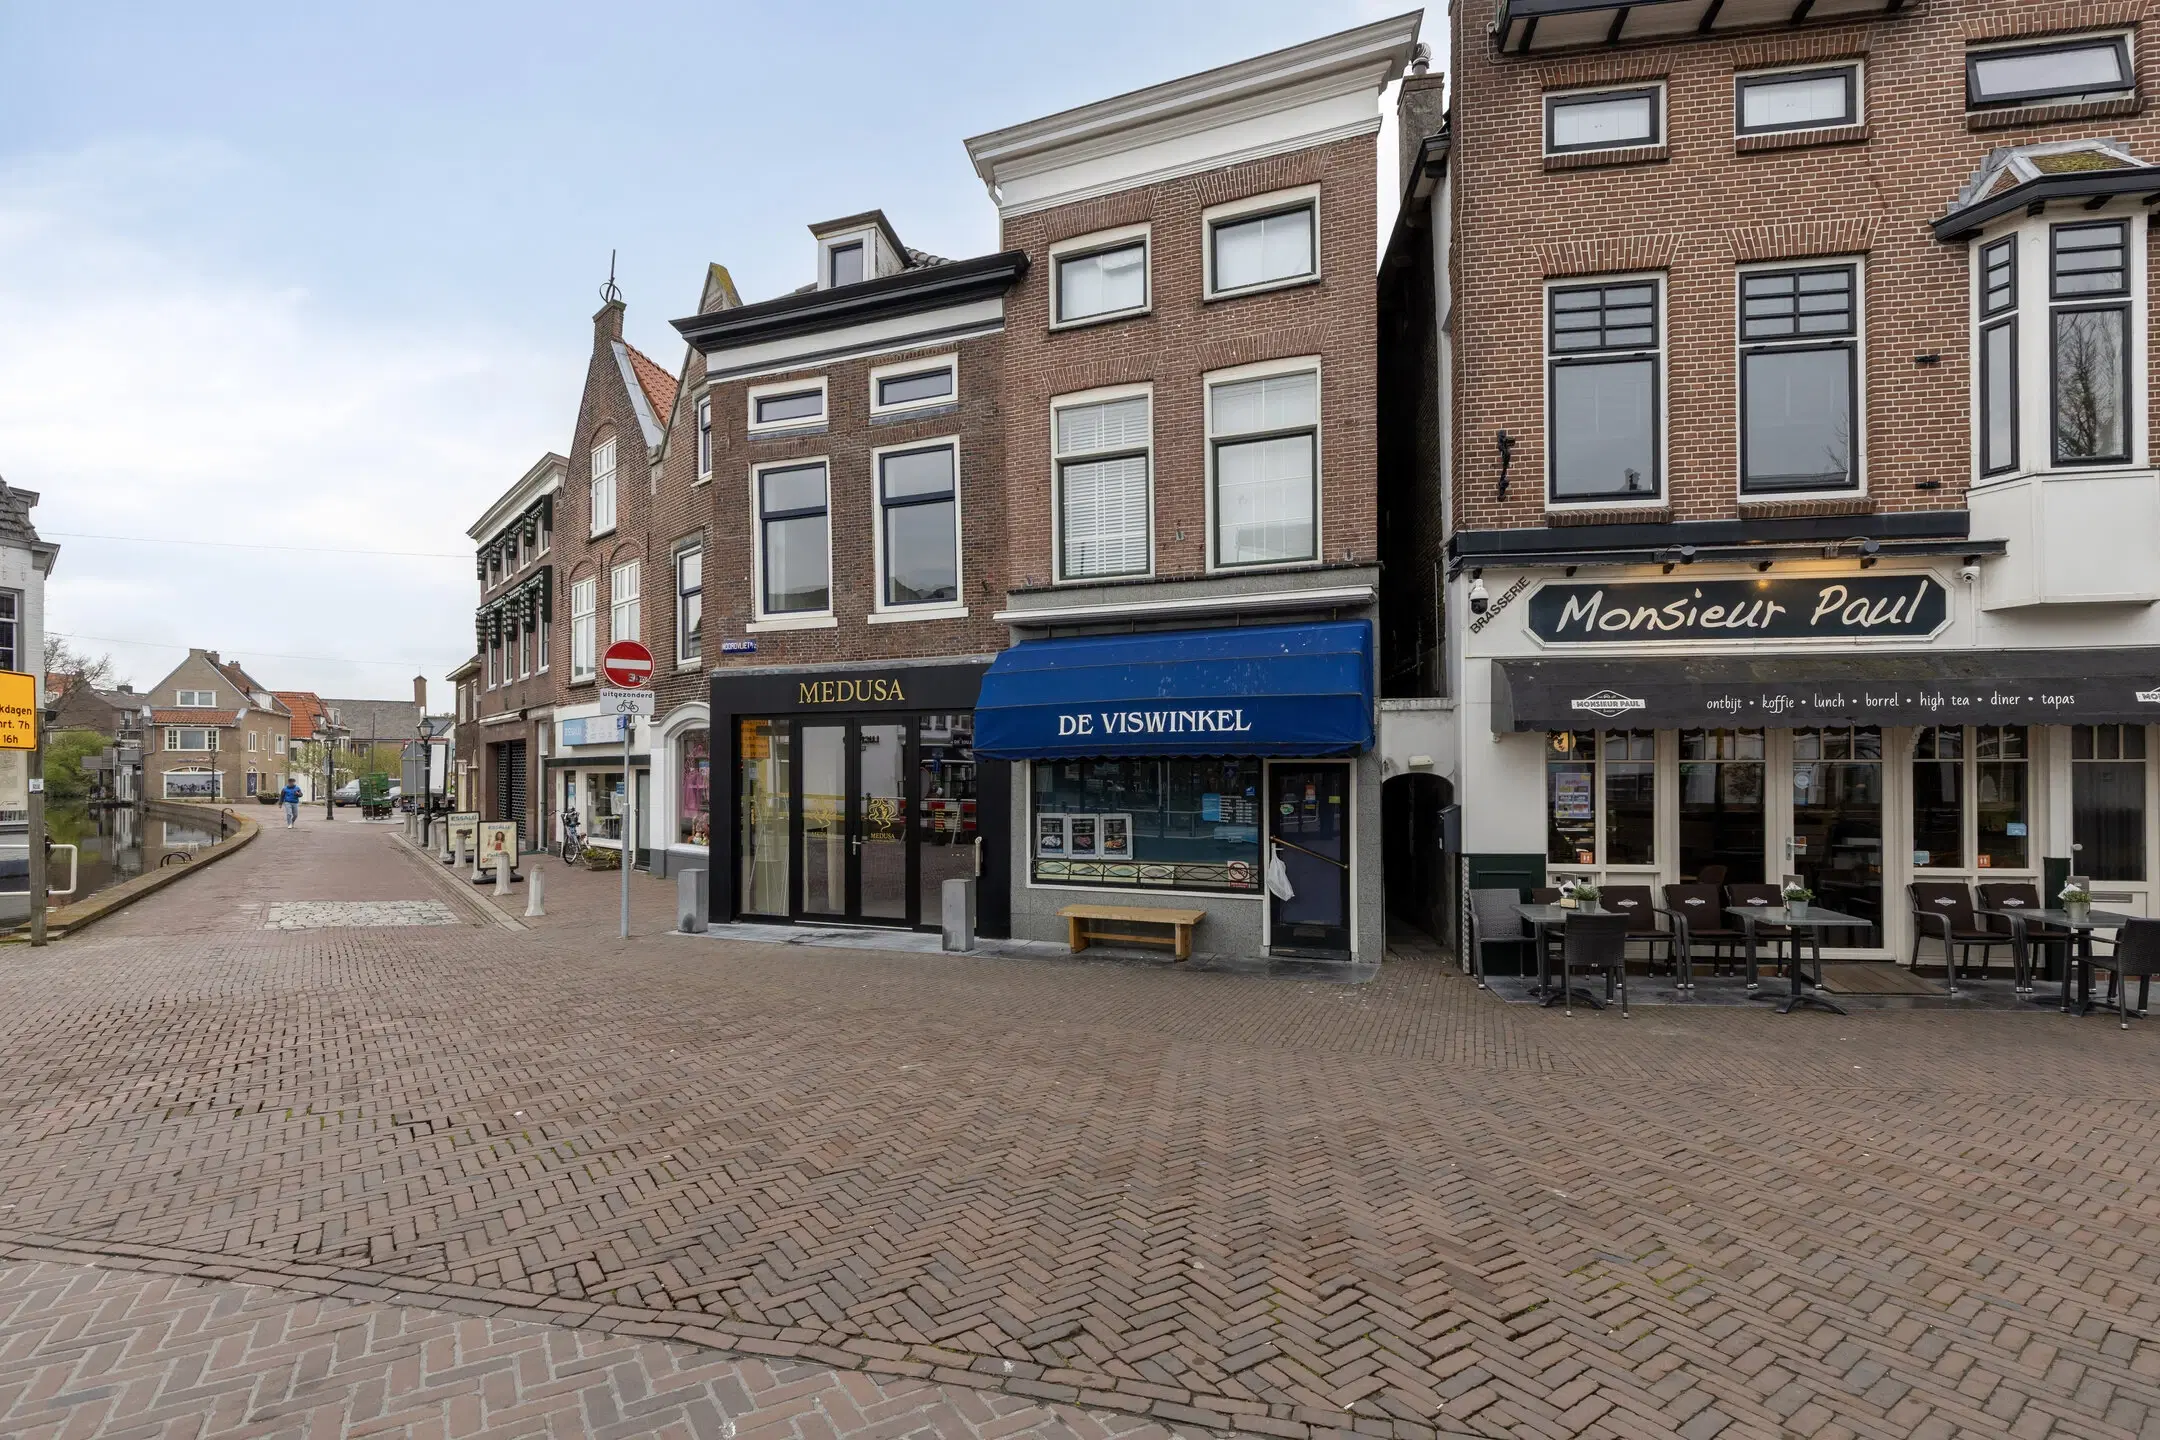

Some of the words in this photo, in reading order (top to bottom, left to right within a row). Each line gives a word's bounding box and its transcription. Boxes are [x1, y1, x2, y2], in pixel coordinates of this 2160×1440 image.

[1469, 576, 1531, 635] BRASSERIE
[1555, 588, 1786, 632] Monsieur
[1810, 579, 1929, 627] Paul
[798, 679, 906, 704] MEDUSA
[1706, 695, 1742, 714] ontbijt
[1762, 694, 1795, 714] koffie
[1814, 693, 1845, 708] lunch
[1865, 692, 1899, 707] borrel
[1920, 691, 1945, 711] high
[1951, 695, 1970, 706] tea
[1990, 690, 2021, 706] diner
[2041, 693, 2075, 710] tapas
[18, 720, 30, 730] 7h
[1058, 714, 1094, 736] DE
[1101, 709, 1252, 734] VISWINKEL
[3, 734, 19, 744] 16h
